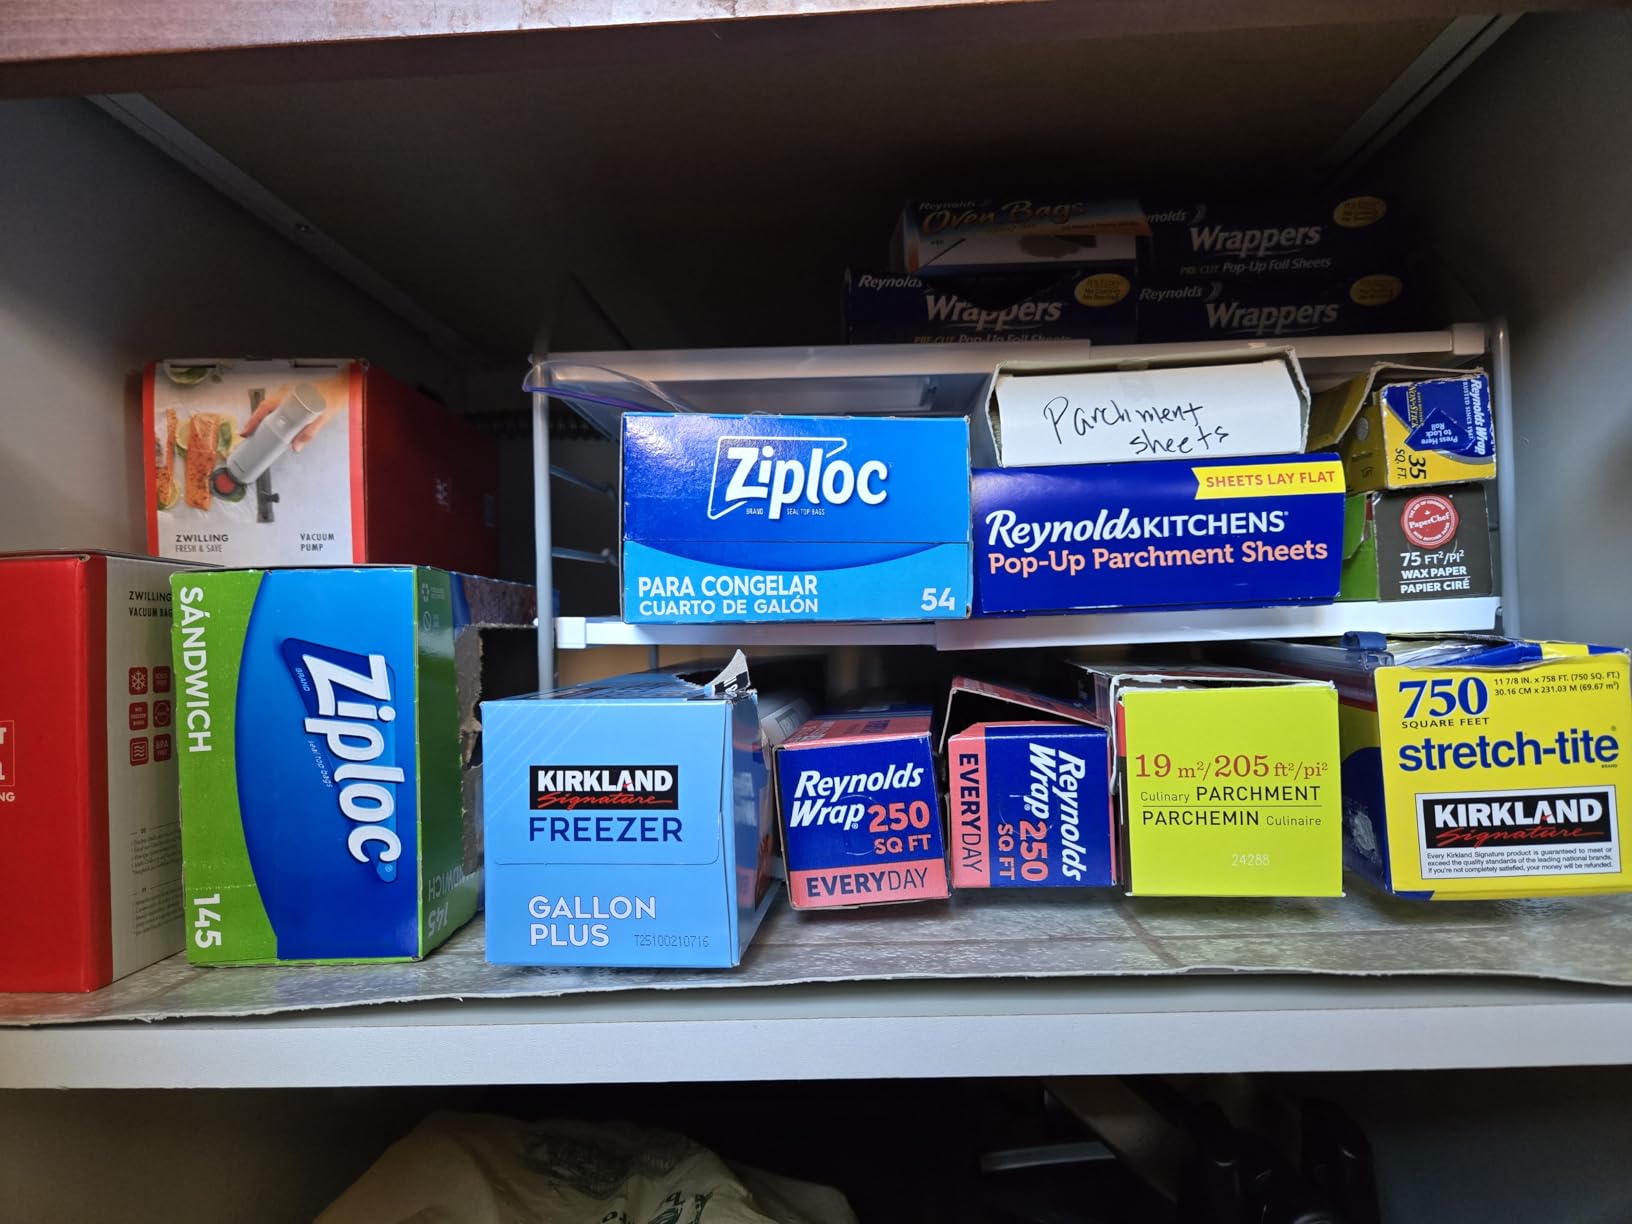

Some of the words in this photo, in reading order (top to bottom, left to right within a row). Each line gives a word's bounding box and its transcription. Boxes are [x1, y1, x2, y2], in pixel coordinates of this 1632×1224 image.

[921, 210, 996, 233] Oven
[1002, 200, 1089, 225] Bags
[1189, 224, 1324, 256] Wrappers
[1222, 261, 1267, 275] Pop-Up
[1268, 260, 1291, 271] Foil
[1292, 258, 1333, 269] Sheets
[1140, 286, 1203, 302] Reynolds
[926, 295, 1064, 331] Wrappers
[1206, 302, 1341, 335] Wrappers
[1469, 379, 1485, 426] Reynolds
[1043, 396, 1204, 444] Parchment
[1130, 425, 1229, 454] sheets
[1474, 426, 1487, 455] Wrap
[1408, 454, 1426, 479] 35
[725, 446, 888, 519] Ziploc
[1206, 474, 1262, 488] SHEETS
[1268, 472, 1295, 485] LAY
[1300, 471, 1336, 484] FLAT
[300, 533, 335, 541] VACUUM
[988, 550, 1086, 577] Pop-Up
[1093, 543, 1234, 570] Parchment
[1242, 540, 1328, 562] Sheets
[1400, 552, 1421, 566] 75
[1401, 569, 1429, 579] WAX
[1431, 566, 1467, 577] PAPER
[129, 591, 172, 602] ZWILLING
[639, 577, 691, 597] PARA
[701, 575, 818, 596] CONGELAR
[1400, 582, 1441, 594] PAPIER
[1443, 578, 1470, 590] CIRÉ
[129, 607, 158, 617] VACUUM
[640, 600, 715, 615] CUARTO
[723, 600, 747, 614] DE
[754, 595, 818, 614] GALÓN
[921, 587, 956, 612] 54
[180, 586, 212, 753] SÁNDWICH
[295, 667, 310, 692] BRAND
[1505, 677, 1519, 685] 7/8
[1521, 676, 1532, 684] IN.
[1571, 673, 1588, 682] (750
[1590, 672, 1604, 680] SQ.
[1398, 676, 1488, 720] 750
[1495, 687, 1516, 696] 30.16
[1541, 685, 1567, 693] 231.03
[1579, 683, 1603, 693] (69.67
[1401, 718, 1455, 729] SQUARE
[1460, 717, 1490, 727] FEET
[302, 654, 405, 863] Ziploc
[1399, 728, 1619, 772] stretch-tite
[1135, 754, 1171, 778] 19
[538, 769, 673, 792] KIRKLAND
[794, 763, 924, 802] Reynolds
[1023, 742, 1056, 820] Wrap
[537, 792, 673, 811] Signature
[1140, 791, 1190, 804] Culinary
[1196, 786, 1321, 801] PARCHMENT
[790, 799, 865, 830] Wrap
[868, 800, 930, 833] 250
[959, 753, 982, 872] EVERYDAY
[1052, 750, 1087, 881] Reynolds
[1143, 810, 1259, 825] PARCHEMIN
[1266, 815, 1322, 826] Culinaire
[1434, 798, 1603, 828] KIRKLAND
[529, 817, 683, 842] FREEZER
[997, 823, 1015, 852] SQ
[1435, 827, 1605, 849] Signature
[874, 838, 903, 855] SQ
[908, 834, 931, 851] FT
[1020, 820, 1048, 881] 250
[1475, 851, 1505, 859] Signature
[1507, 850, 1531, 859] product
[1541, 848, 1576, 856] guaranteed
[999, 857, 1015, 880] FT
[807, 867, 928, 898] EVERYDAY
[528, 896, 656, 919] GALLON
[193, 893, 222, 949] 145
[530, 923, 609, 947] PLUS
